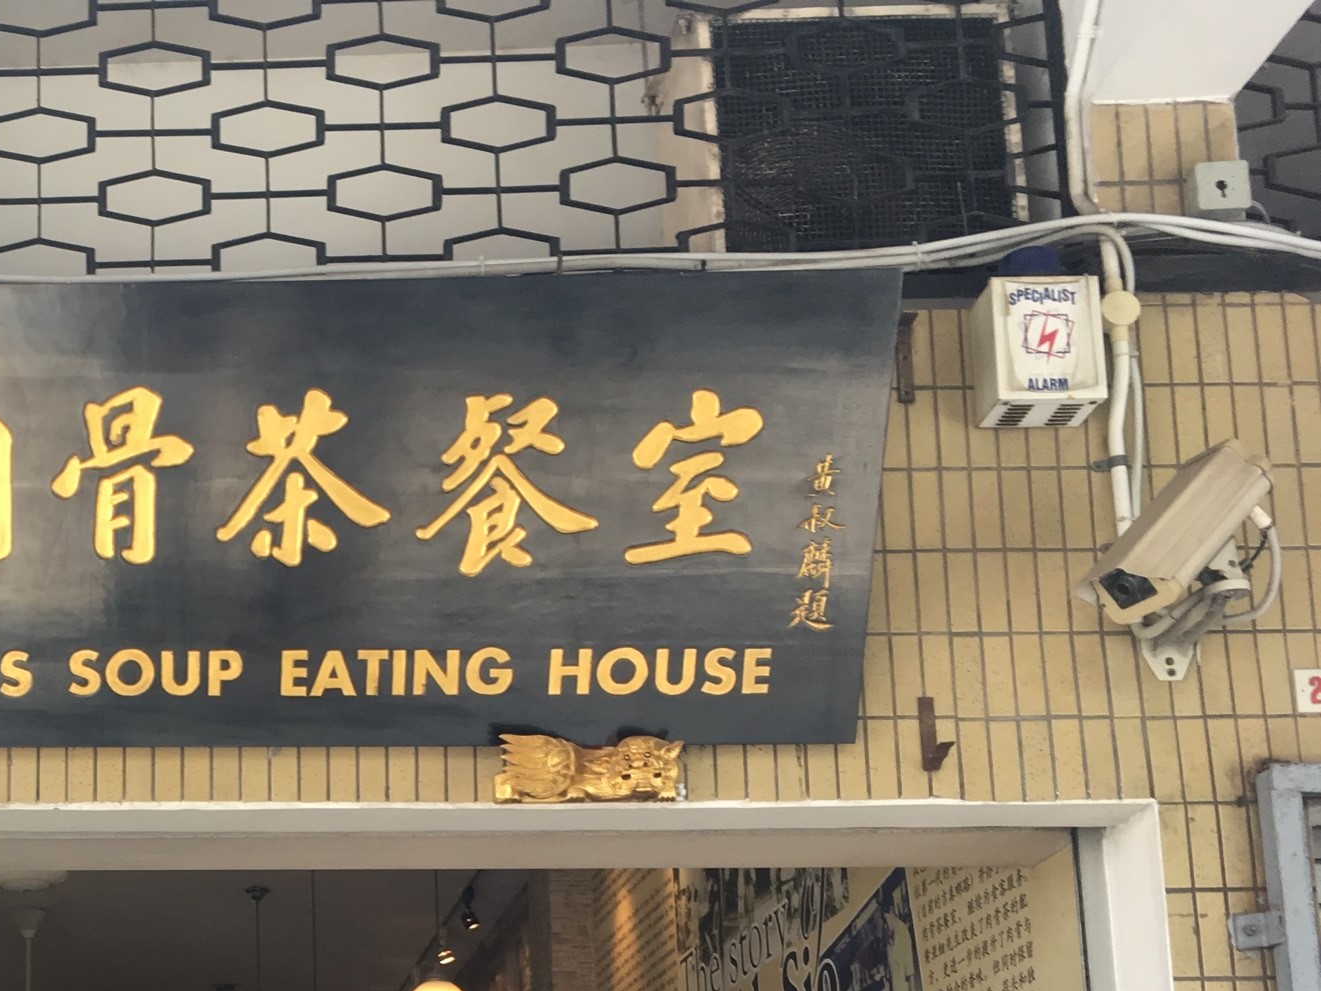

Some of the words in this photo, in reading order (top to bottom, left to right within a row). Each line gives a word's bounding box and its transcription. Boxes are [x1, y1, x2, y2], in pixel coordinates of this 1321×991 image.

[1008, 287, 1077, 306] SPECIALIST
[1027, 378, 1069, 391] ALARM
[68, 647, 244, 697] SOUP
[280, 646, 512, 697] EATING
[547, 646, 773, 696] HOUSE
[729, 902, 789, 985] story
